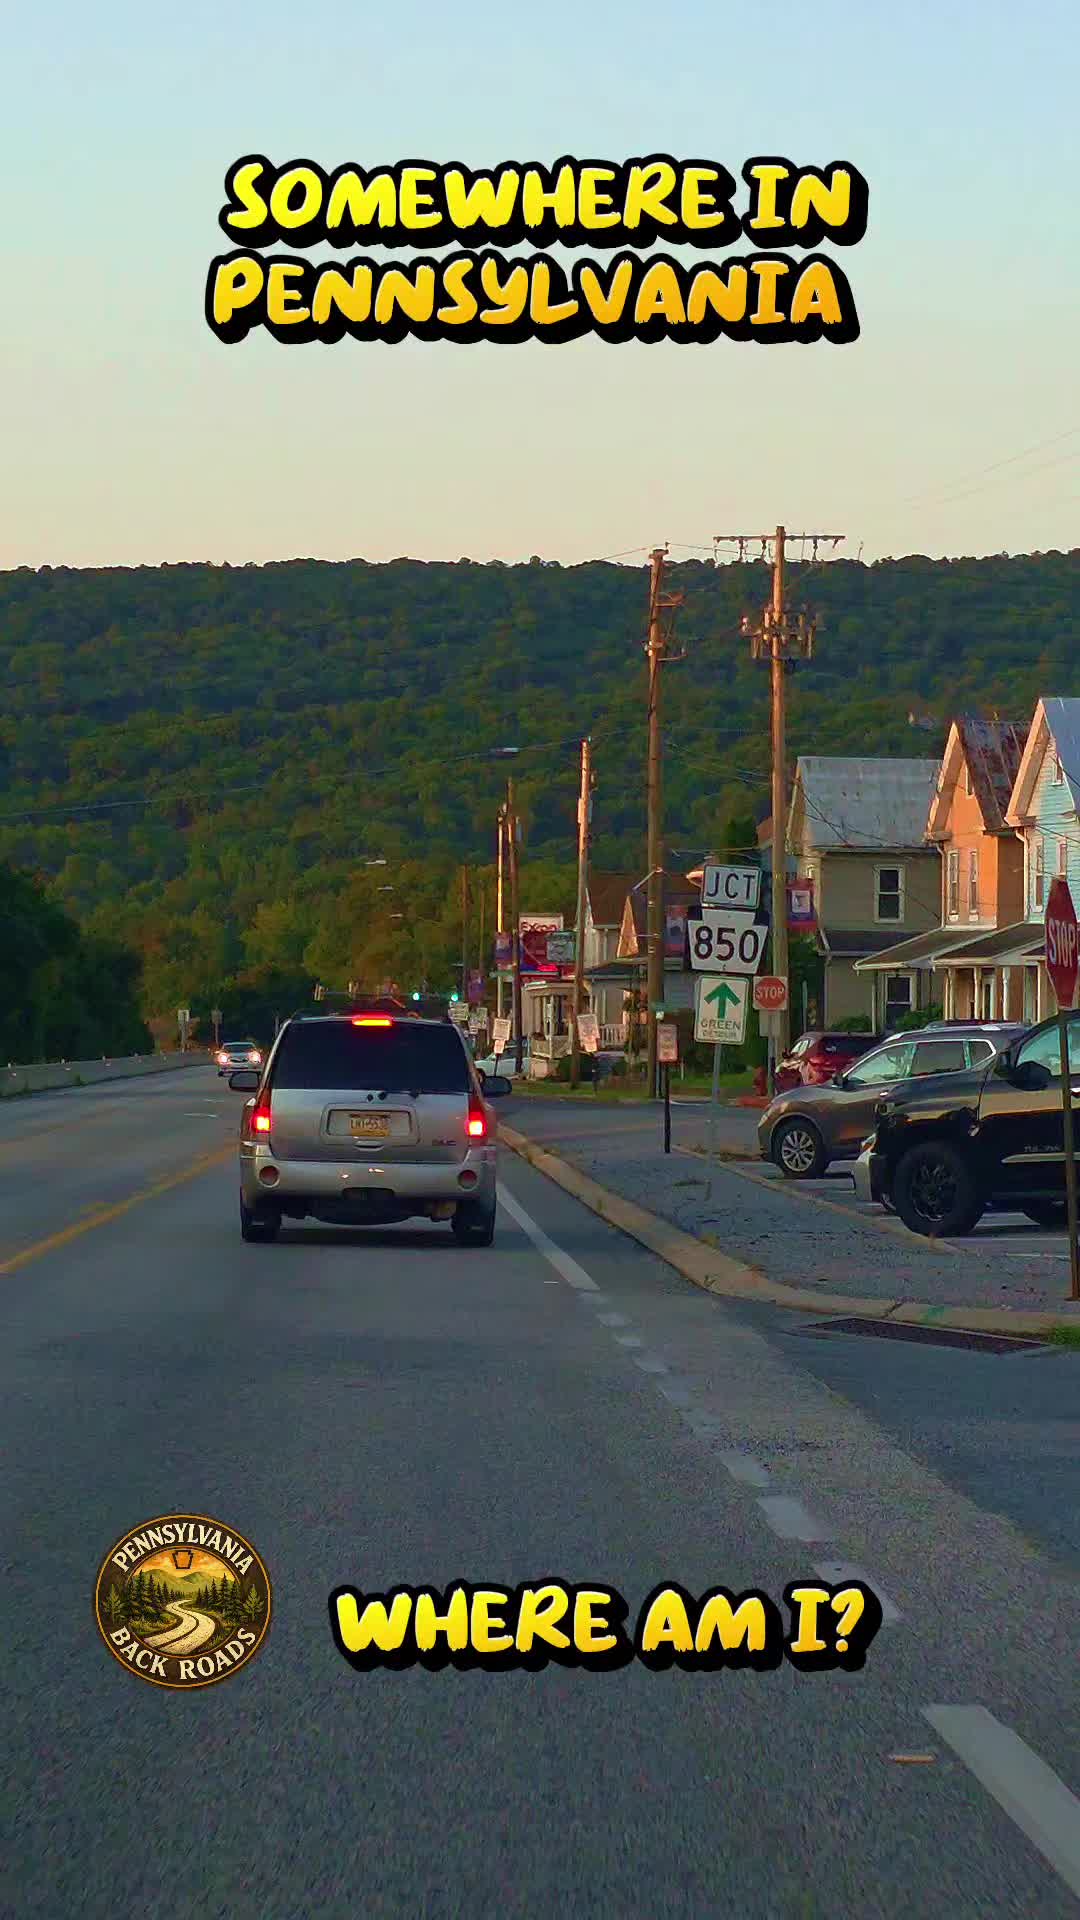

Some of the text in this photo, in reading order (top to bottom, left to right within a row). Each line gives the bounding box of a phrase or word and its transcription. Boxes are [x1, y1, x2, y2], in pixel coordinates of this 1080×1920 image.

[705, 871, 756, 900] JCT
[694, 925, 759, 964] 850
[1049, 917, 1076, 968] STOP
[755, 985, 785, 1000] STOP
[700, 1018, 741, 1030] GREEN
